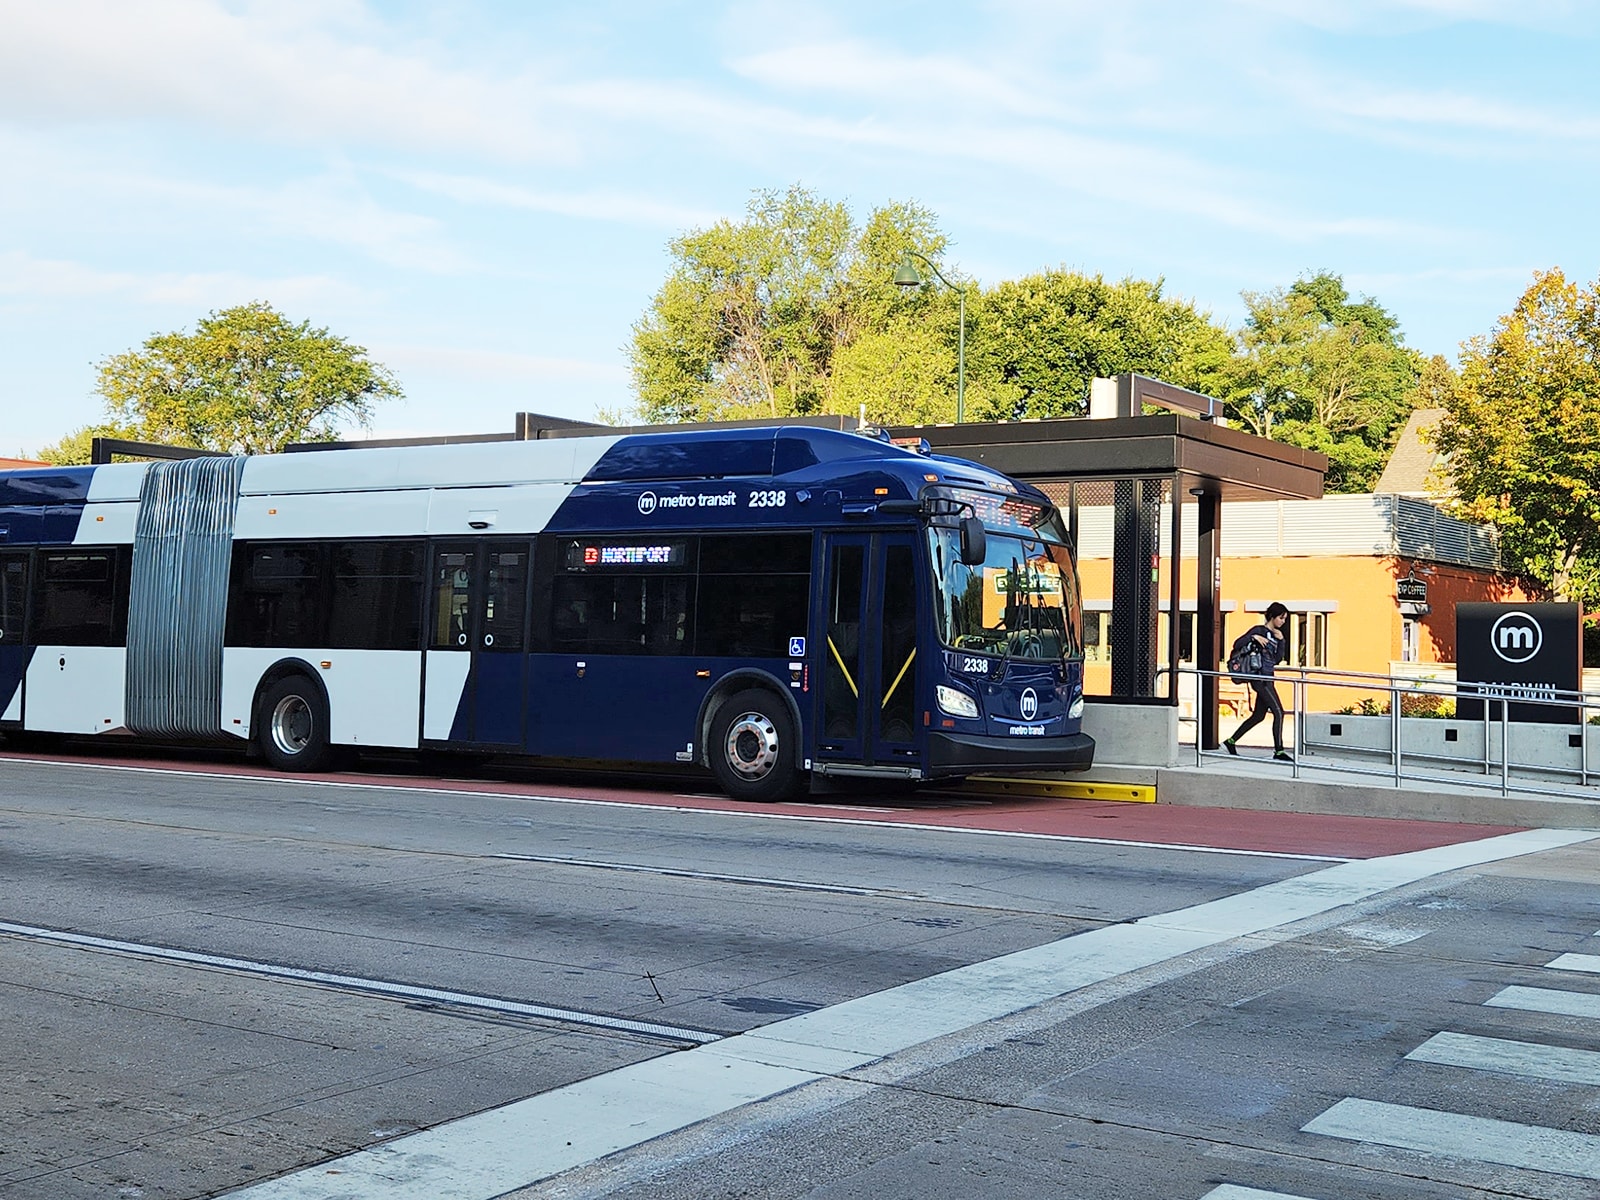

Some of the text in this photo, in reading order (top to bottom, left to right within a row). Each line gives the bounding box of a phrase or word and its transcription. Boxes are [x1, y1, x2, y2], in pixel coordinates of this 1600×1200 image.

[659, 494, 696, 508] metro
[697, 490, 737, 507] transit
[748, 490, 786, 508] 2338
[601, 546, 671, 563] NORTHPORT
[963, 657, 988, 673] 2338
[1009, 724, 1046, 736] metro transit
